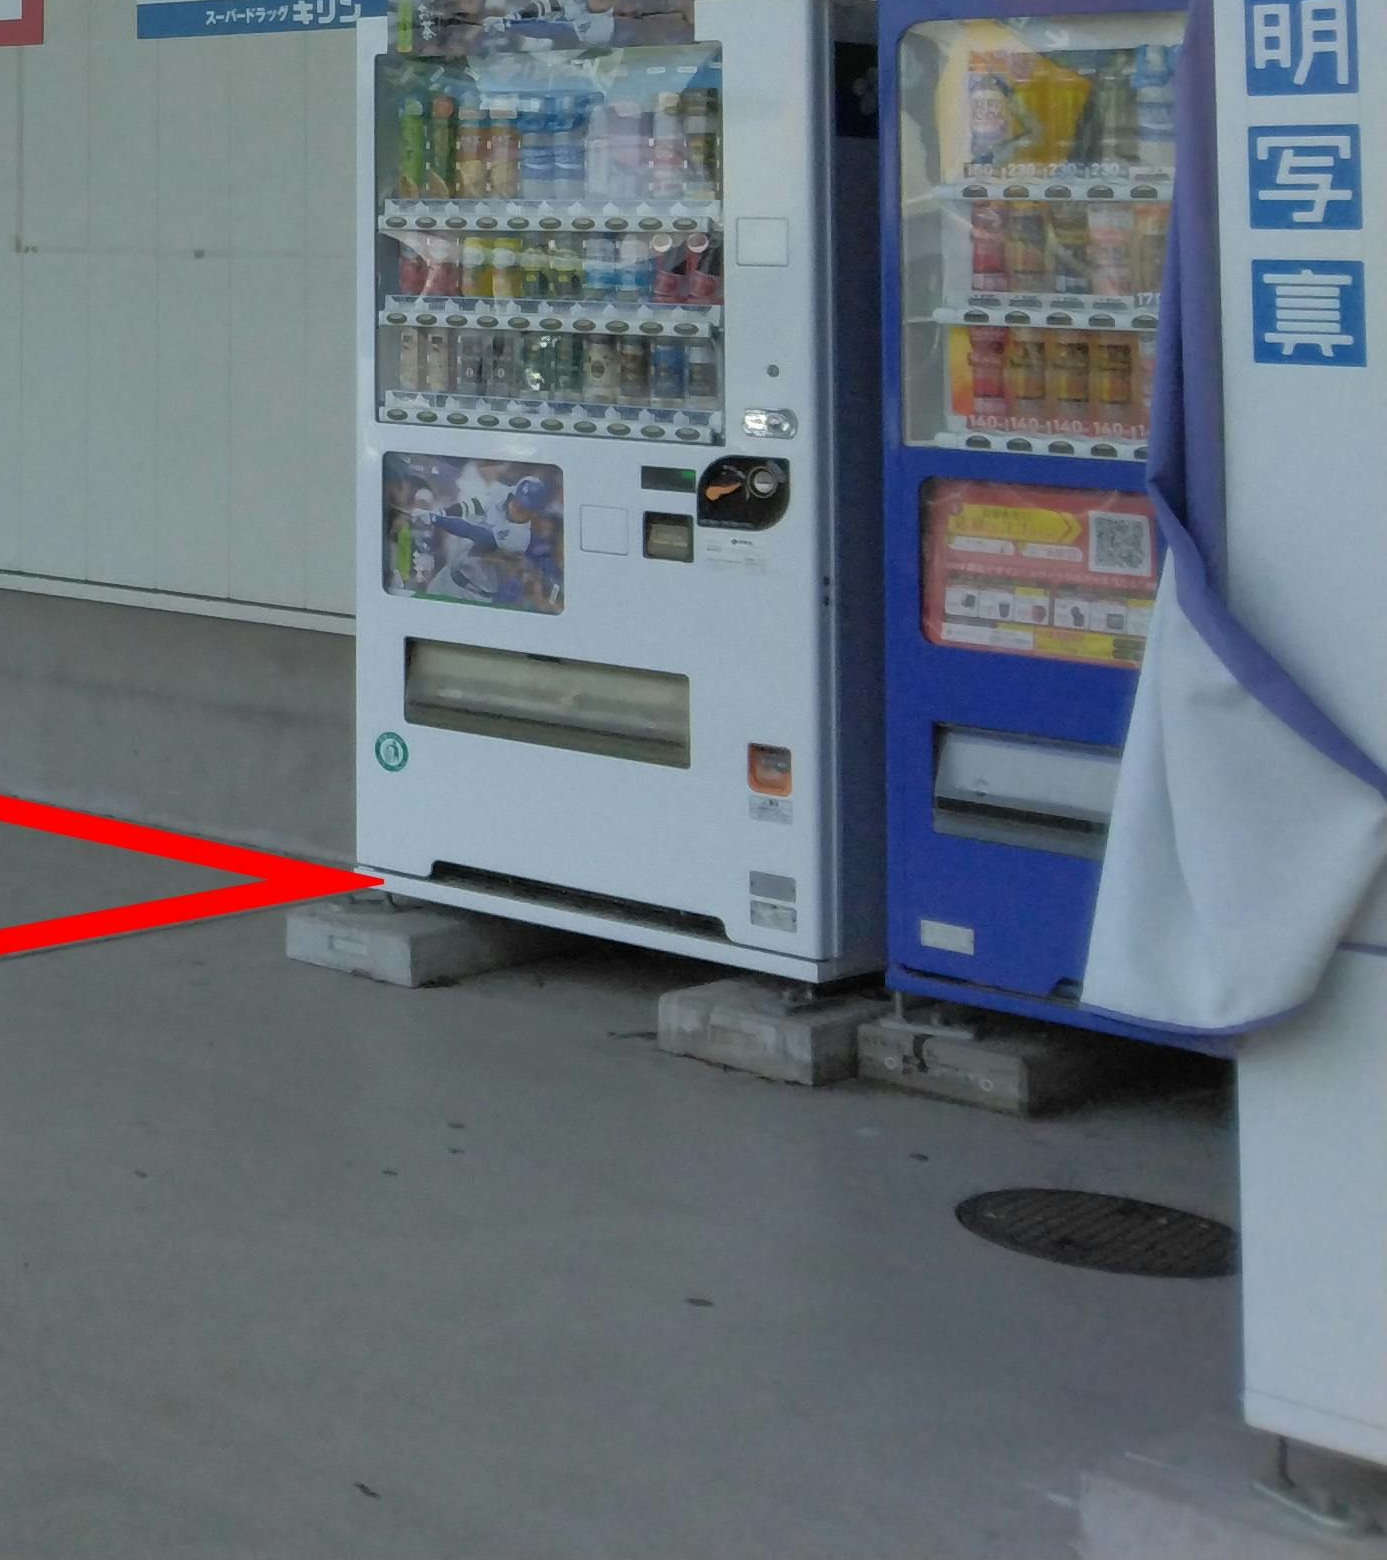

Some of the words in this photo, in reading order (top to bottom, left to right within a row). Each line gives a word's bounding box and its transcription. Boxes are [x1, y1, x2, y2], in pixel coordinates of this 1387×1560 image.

[205, 5, 289, 26] スーパードラッグ
